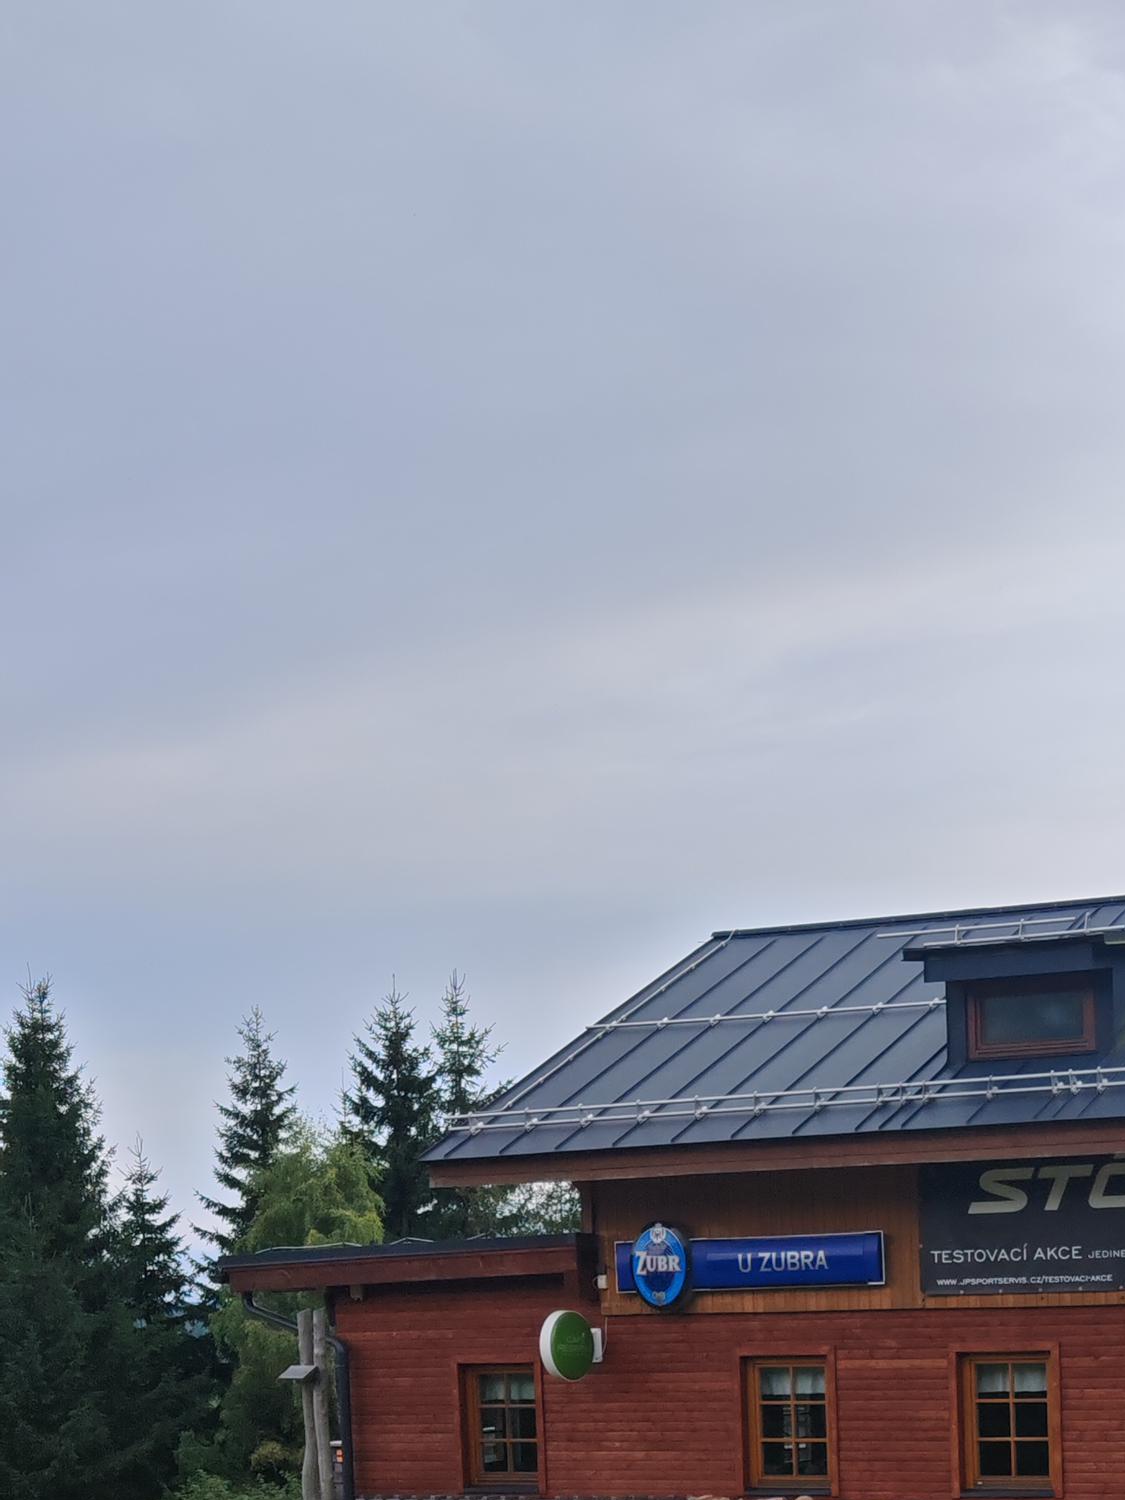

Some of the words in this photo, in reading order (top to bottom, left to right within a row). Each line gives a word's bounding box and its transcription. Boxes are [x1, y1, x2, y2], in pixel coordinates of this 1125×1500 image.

[635, 1250, 682, 1276] ZUBR
[737, 1253, 752, 1273] U
[758, 1250, 829, 1272] ZUBRA
[930, 1243, 1029, 1263] TESTOVACÍ
[1033, 1245, 1082, 1260] AKCE
